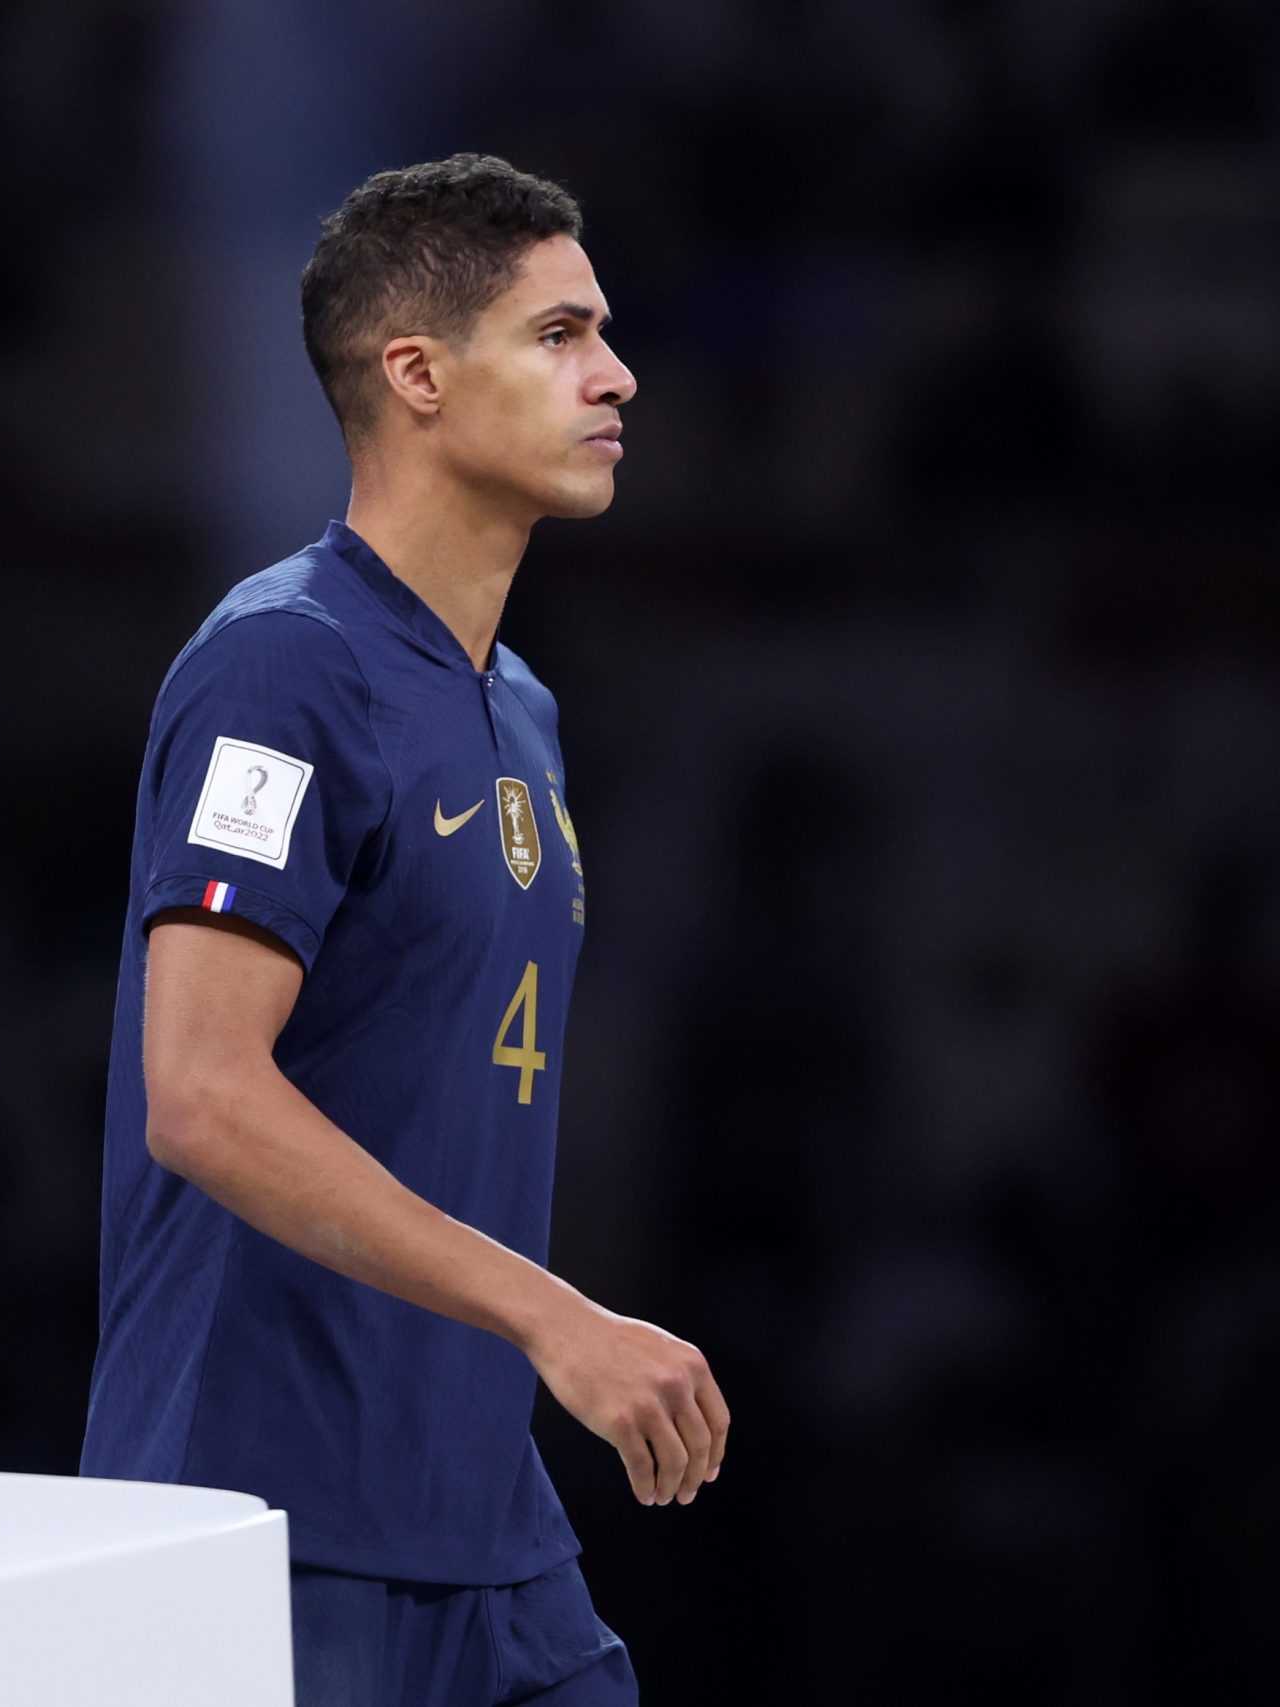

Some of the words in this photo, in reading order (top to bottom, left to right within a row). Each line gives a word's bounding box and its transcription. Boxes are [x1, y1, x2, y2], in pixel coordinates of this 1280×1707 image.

[212, 812, 229, 822] FIFA
[230, 816, 259, 830] WORLD
[259, 825, 274, 834] CUP
[511, 846, 530, 860] FIFA
[492, 959, 546, 1105] 4
